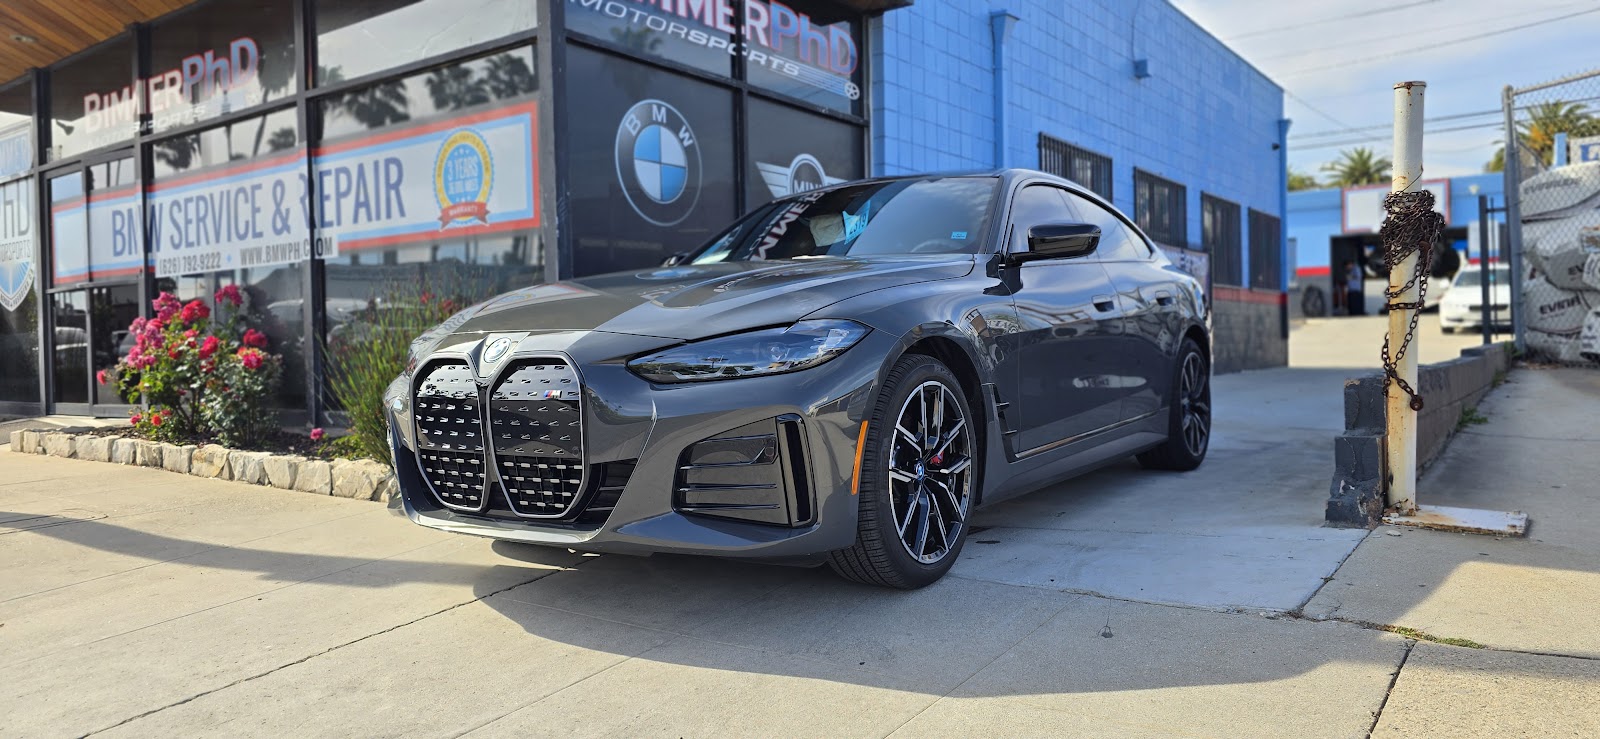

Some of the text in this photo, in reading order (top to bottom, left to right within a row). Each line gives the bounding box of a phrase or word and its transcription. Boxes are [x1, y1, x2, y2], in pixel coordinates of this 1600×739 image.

[624, 103, 694, 149] BMW
[455, 155, 479, 180] YEARS
[169, 182, 264, 250] SERVICE
[271, 179, 291, 236] &
[299, 157, 406, 229] REPAIR
[159, 256, 181, 275] (626)
[183, 252, 222, 272] 792-9222
